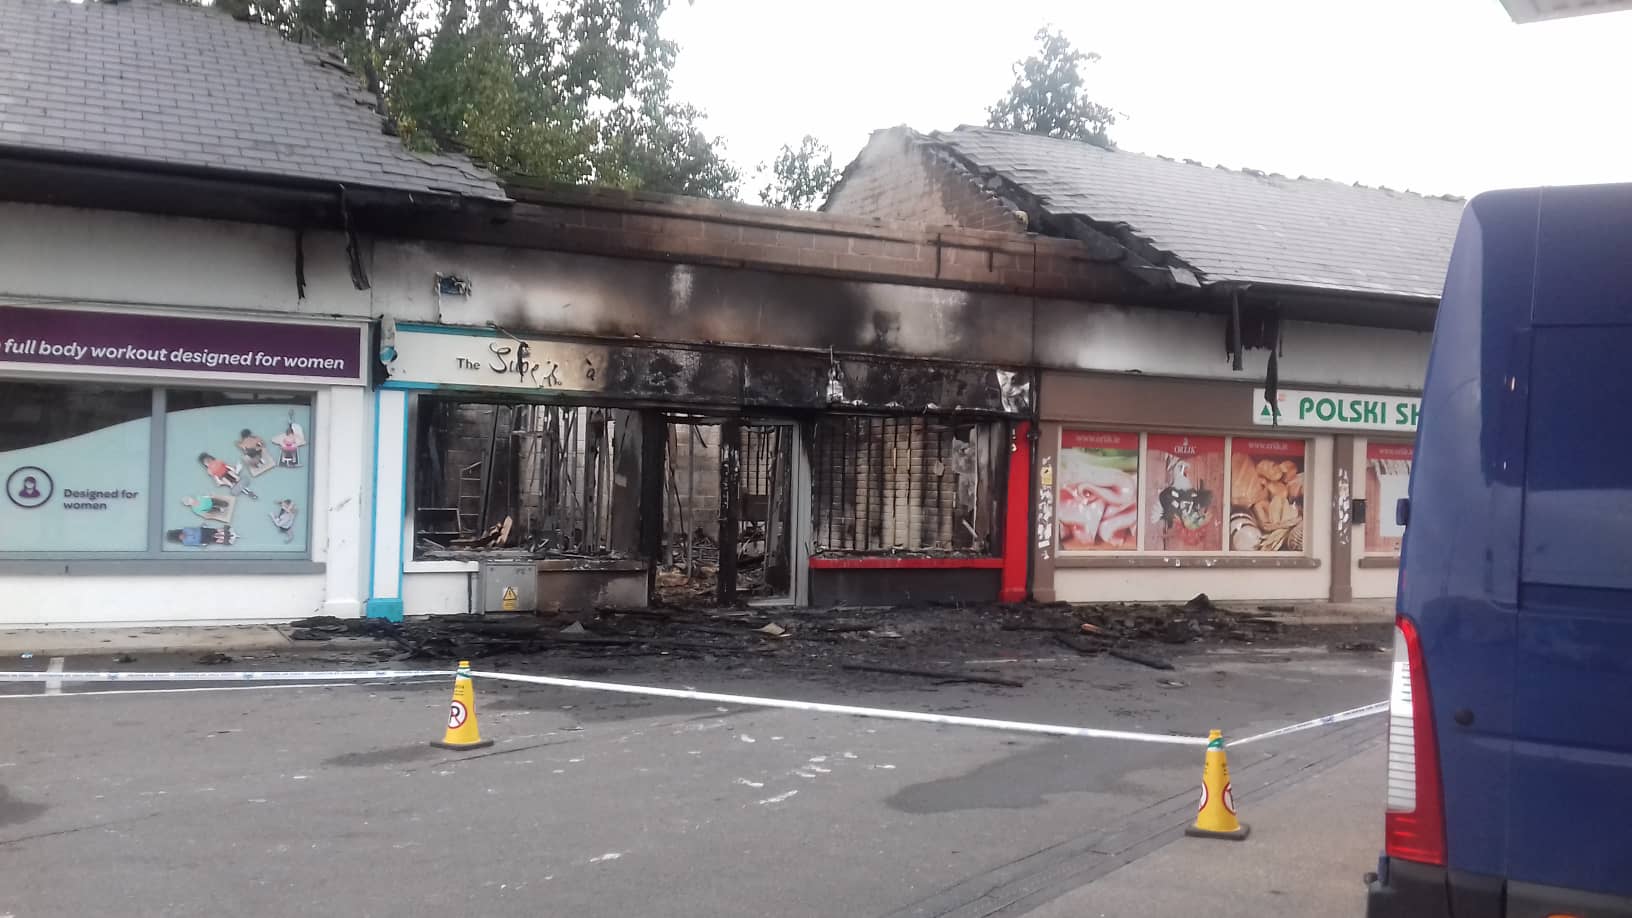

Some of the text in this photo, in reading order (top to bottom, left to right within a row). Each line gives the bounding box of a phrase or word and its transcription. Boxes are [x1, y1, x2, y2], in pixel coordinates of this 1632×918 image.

[4, 338, 345, 370] full body workout designed for women
[456, 358, 481, 370] The
[1299, 396, 1387, 424] POLSKI
[63, 488, 139, 500] Designed for
[63, 502, 108, 510] women
